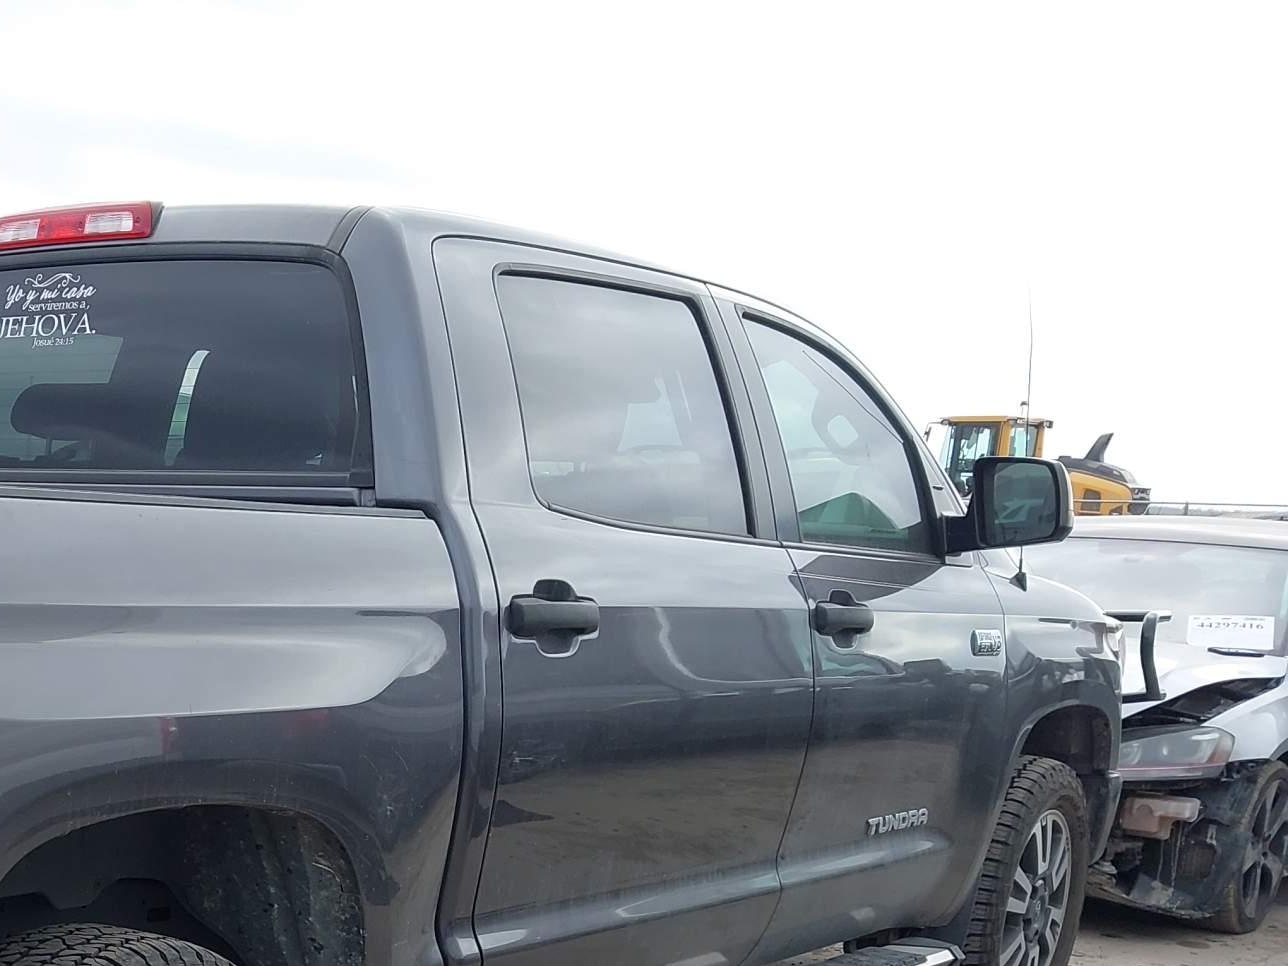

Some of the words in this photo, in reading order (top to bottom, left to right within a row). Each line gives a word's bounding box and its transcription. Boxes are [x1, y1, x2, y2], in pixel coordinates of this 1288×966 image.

[4, 285, 25, 309] Yo
[22, 289, 39, 310] y
[40, 283, 61, 300] mi
[61, 284, 96, 299] casa
[28, 300, 79, 312] serviremos
[32, 337, 54, 349] Josué
[55, 337, 74, 346] 24:15
[867, 808, 929, 836] TUNDRA
